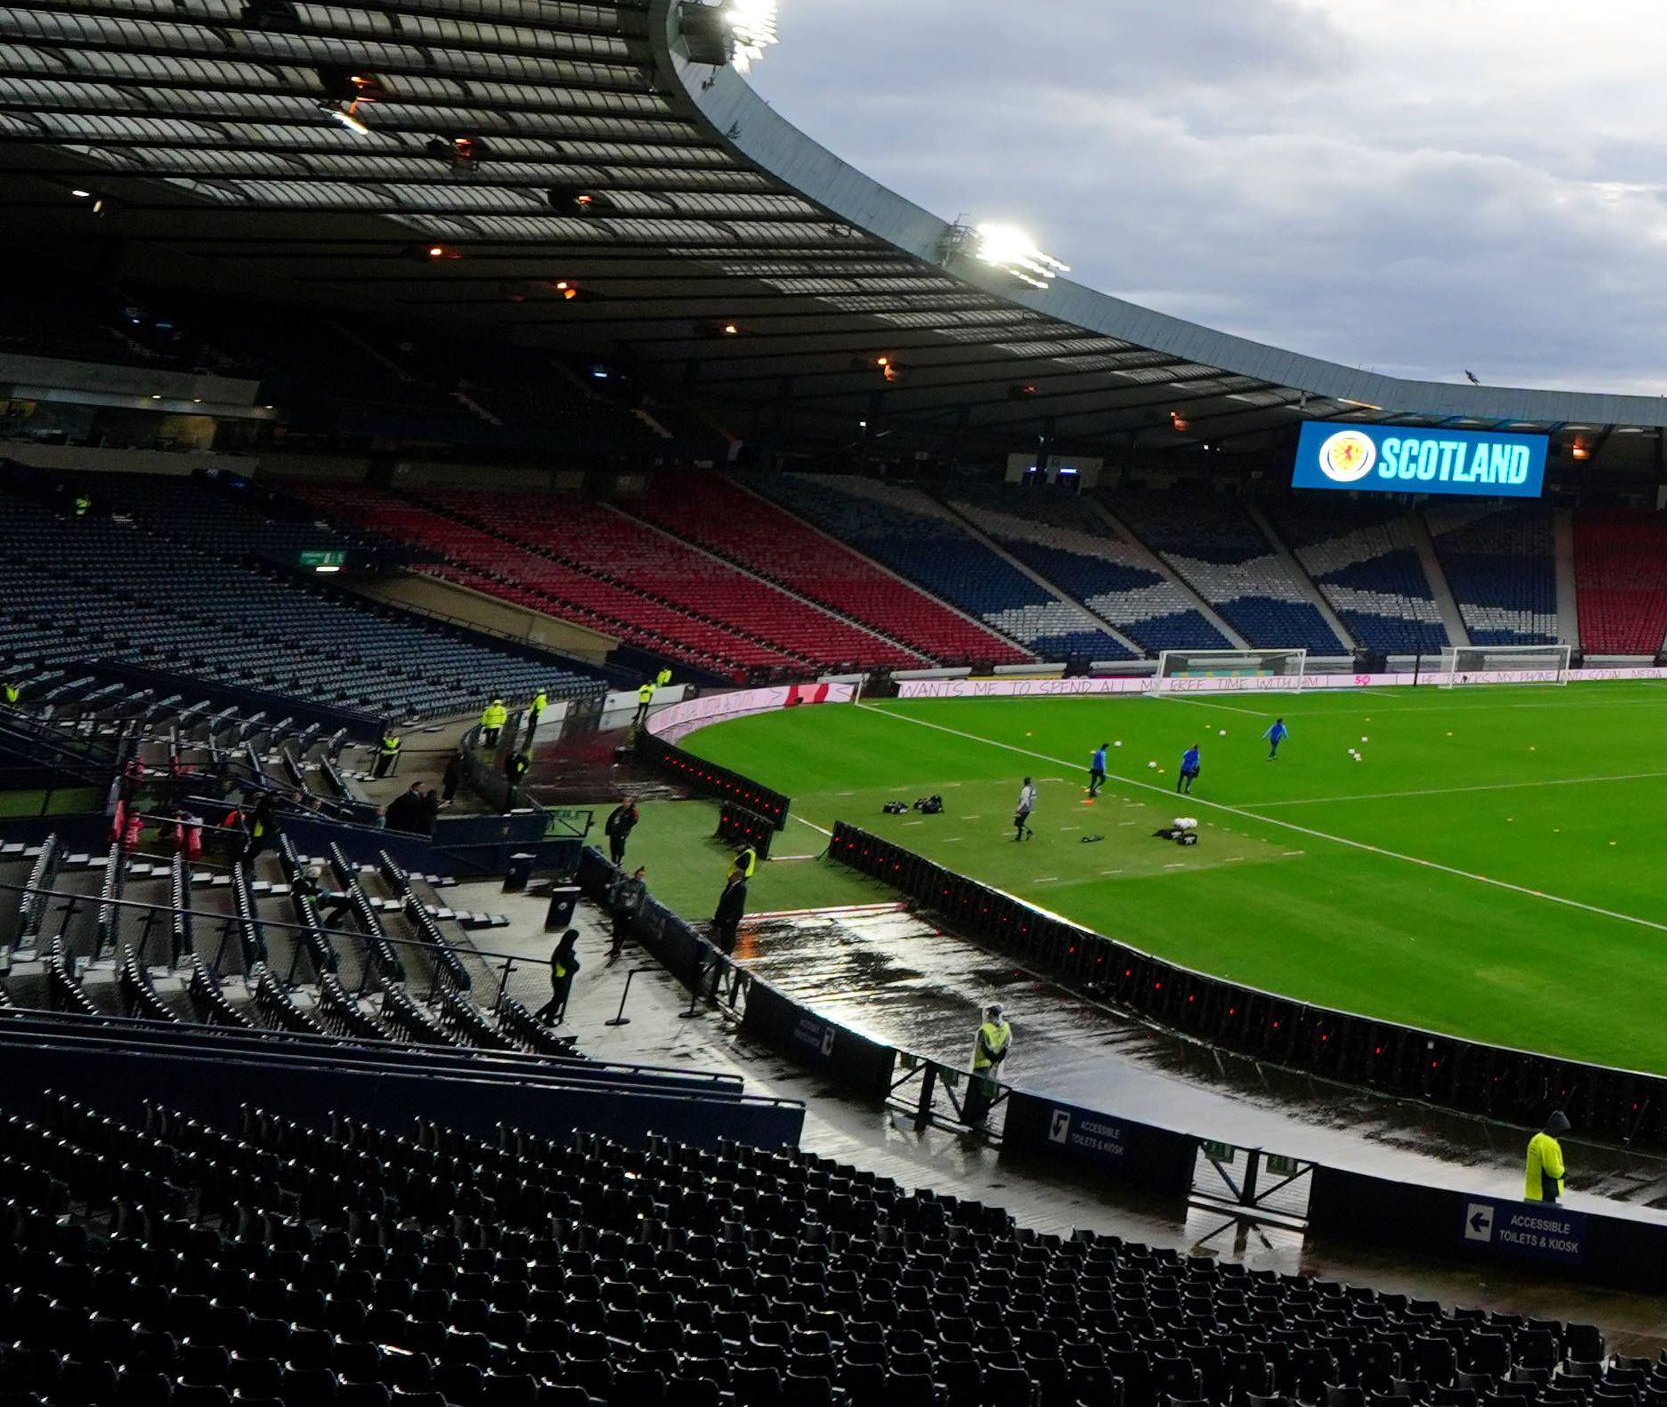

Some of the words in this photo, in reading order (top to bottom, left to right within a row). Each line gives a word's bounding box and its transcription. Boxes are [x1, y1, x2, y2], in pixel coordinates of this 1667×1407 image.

[1378, 437, 1530, 485] SCOTLAND
[900, 681, 964, 697] WANTS
[975, 681, 999, 695] ME
[1011, 681, 1032, 695] TO
[1039, 680, 1092, 694] SPEND
[1100, 680, 1125, 693] ALL
[1171, 678, 1206, 691] FREE
[1217, 677, 1249, 690] TIME
[1256, 676, 1291, 689] WITH
[1510, 1214, 1570, 1235] ACCESSIBLE
[1499, 1229, 1538, 1247] TOILETS
[1538, 1237, 1547, 1248] &
[1548, 1239, 1580, 1254] KIOSK
